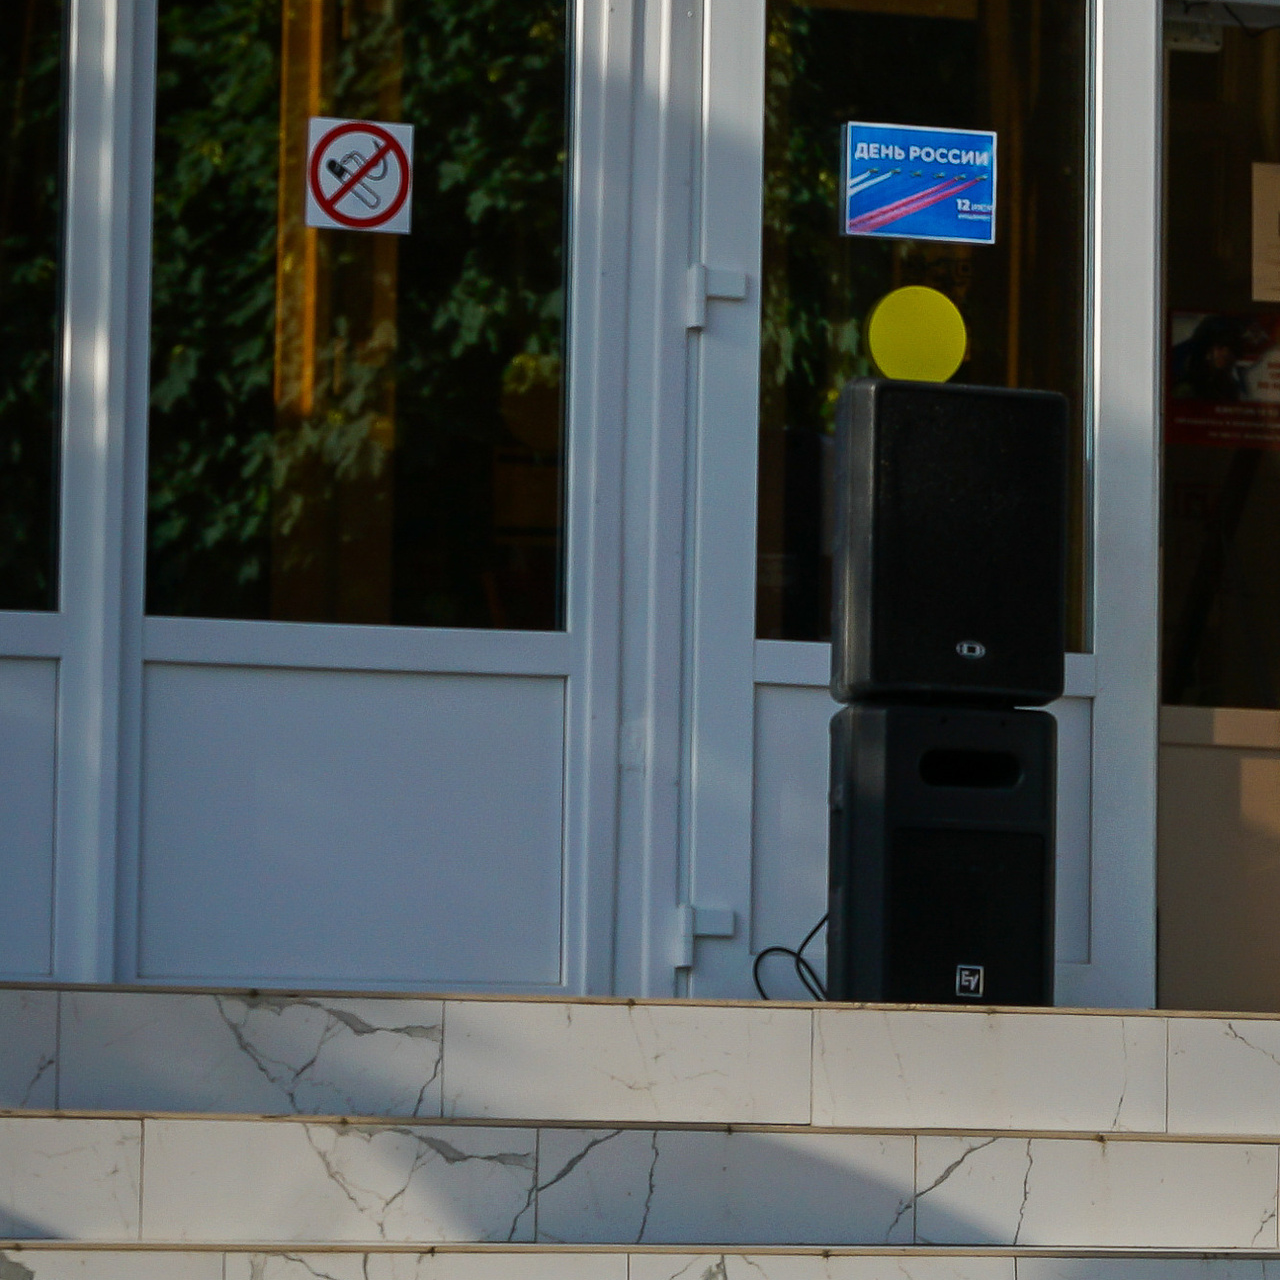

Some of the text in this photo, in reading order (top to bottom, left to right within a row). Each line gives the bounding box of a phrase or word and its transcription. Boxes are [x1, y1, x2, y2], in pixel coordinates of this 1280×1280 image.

[855, 142, 989, 166] ДЕНЬ РОССИИ
[956, 198, 970, 211] 12
